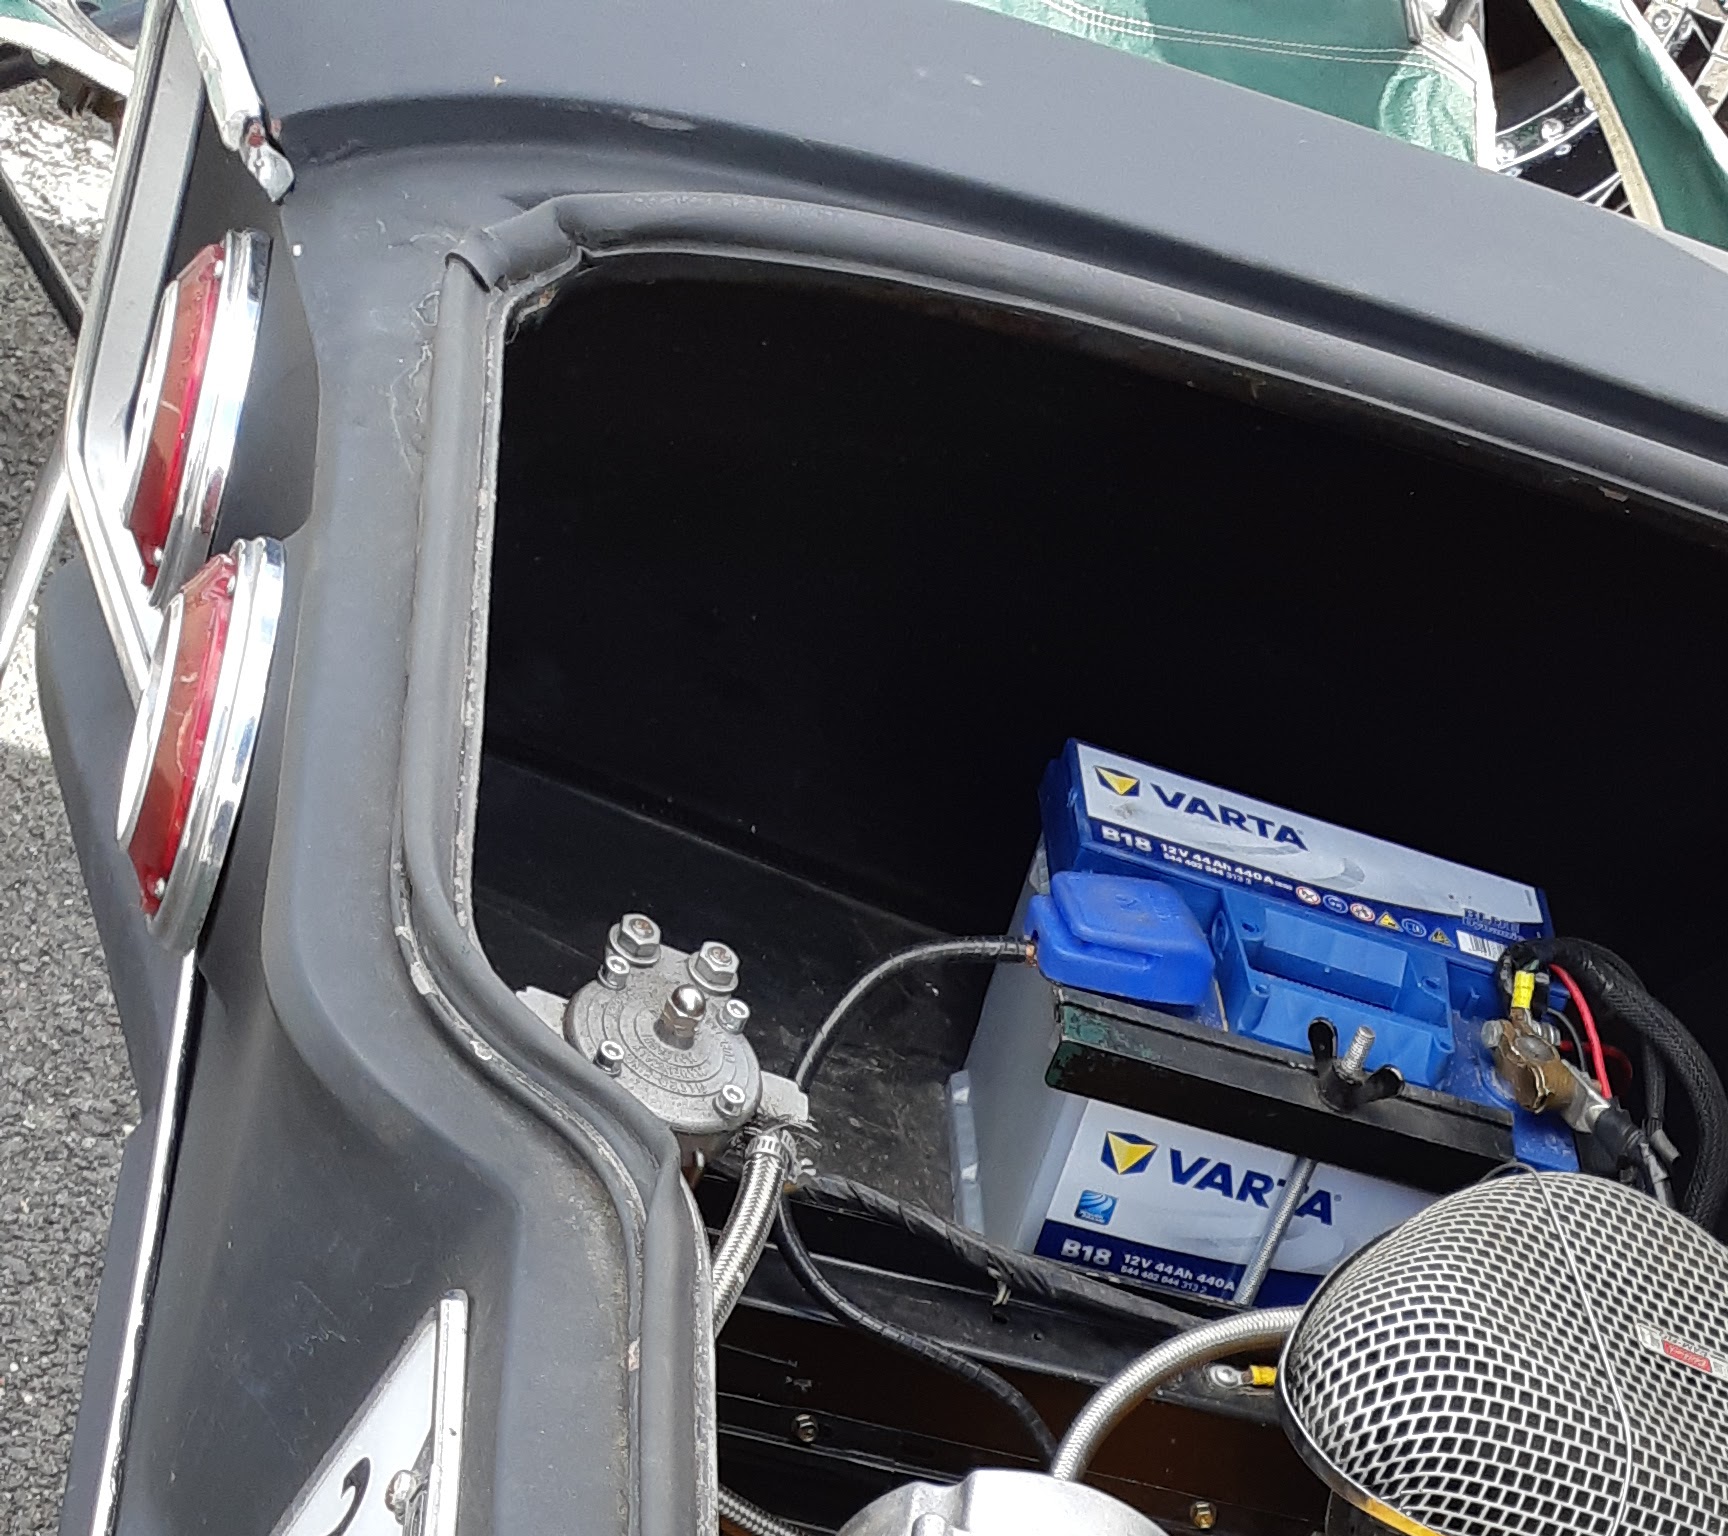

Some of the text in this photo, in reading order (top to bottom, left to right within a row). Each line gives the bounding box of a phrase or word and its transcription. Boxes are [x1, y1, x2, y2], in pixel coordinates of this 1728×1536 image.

[1150, 782, 1309, 852] VARTA
[1101, 825, 1153, 852] B18
[1160, 843, 1189, 859] 12V
[1192, 853, 1232, 872] 44Ah
[1060, 1238, 1236, 1293] B18 12V 44Ah 440A
